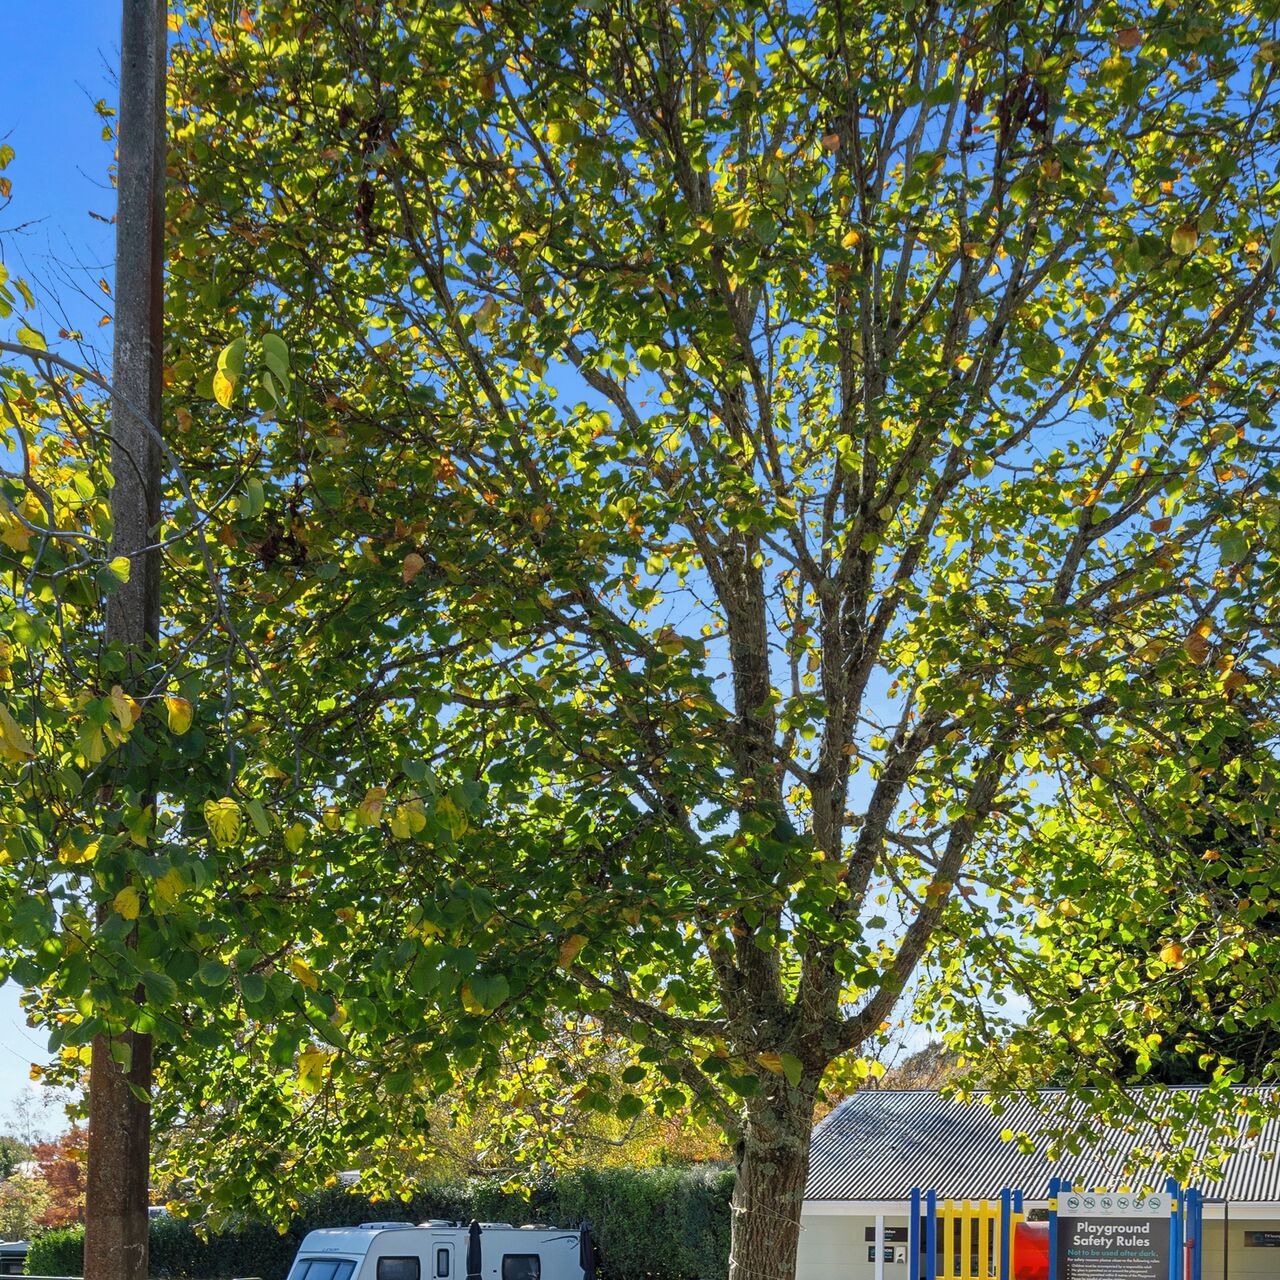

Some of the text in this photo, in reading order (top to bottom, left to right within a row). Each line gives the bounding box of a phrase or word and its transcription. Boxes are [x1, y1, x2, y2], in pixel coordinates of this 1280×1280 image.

[1077, 1222, 1150, 1235] Playground
[1073, 1235, 1150, 1248] Safety Rules
[1120, 1249, 1137, 1257] after
